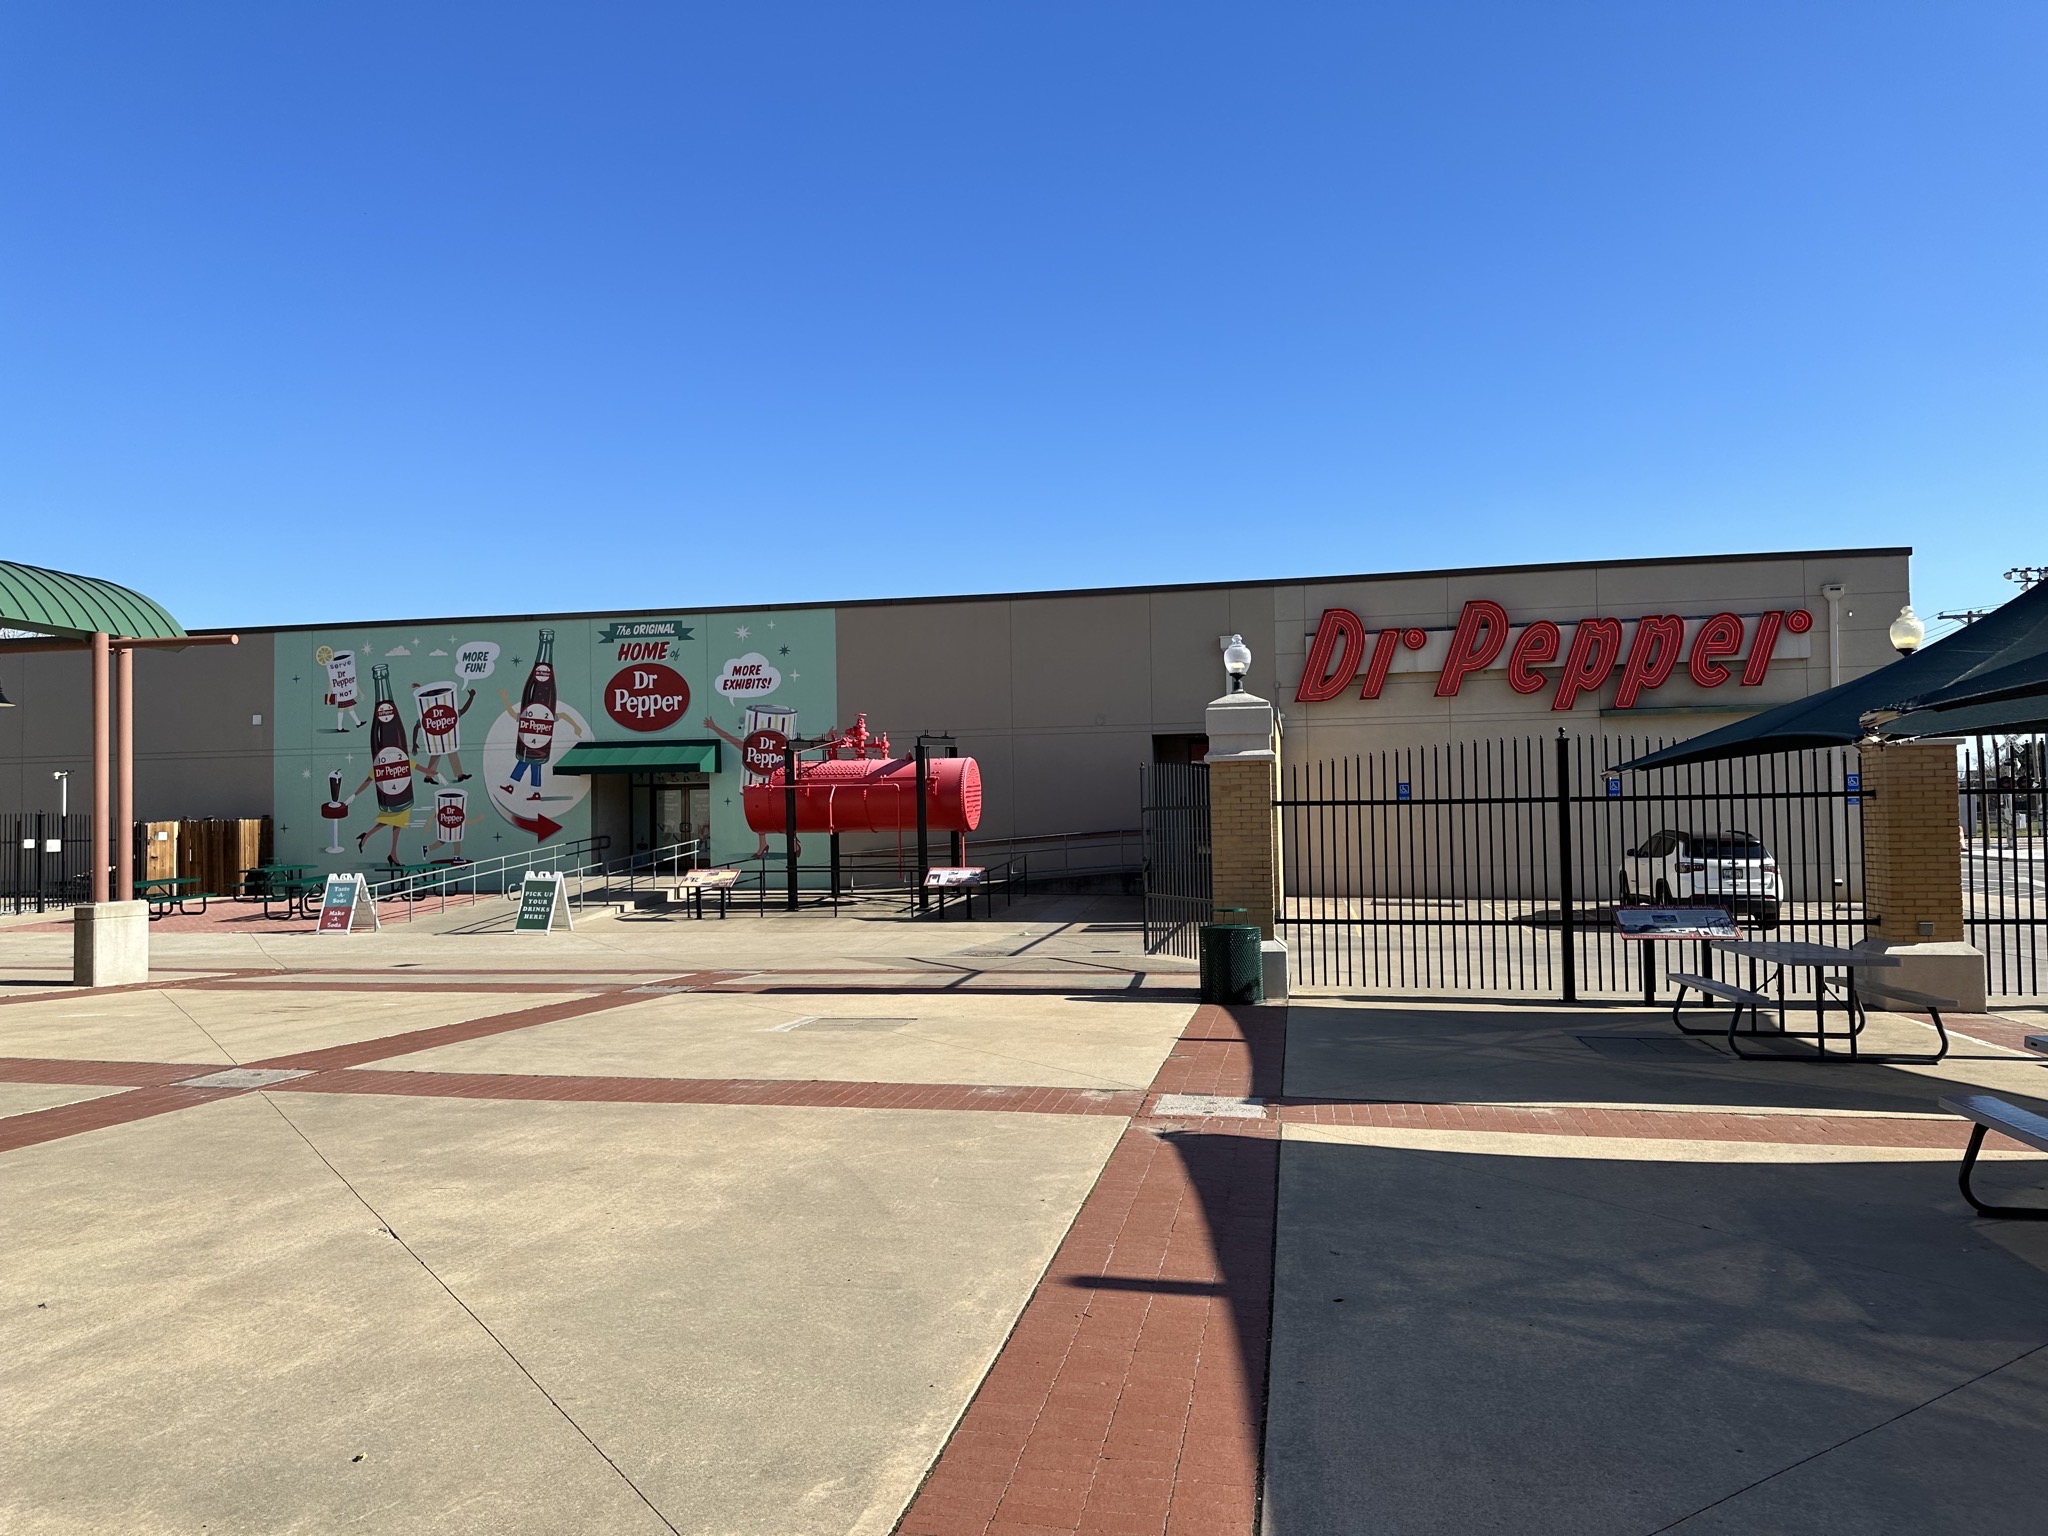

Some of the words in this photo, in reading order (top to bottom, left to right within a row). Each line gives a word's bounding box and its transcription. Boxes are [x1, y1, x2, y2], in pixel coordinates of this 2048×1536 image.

[616, 625, 631, 636] The
[633, 623, 675, 635] ORIGINAL
[462, 651, 489, 662] MORE
[617, 641, 671, 662] HOME
[670, 647, 680, 661] of
[1294, 607, 1427, 703] Dr
[1433, 600, 1814, 711] Pepper
[464, 662, 487, 673] FUN!
[732, 664, 762, 676] MORE
[337, 671, 346, 679] Dr
[633, 670, 658, 690] Dr
[332, 676, 355, 688] Pepper
[722, 677, 772, 690] EXHIBITS!
[339, 690, 352, 698] HOT
[614, 688, 683, 719] Pepper
[433, 709, 444, 718] Dr
[525, 710, 533, 718] 10
[425, 716, 456, 731] Pepper
[520, 720, 530, 729] Dr
[529, 720, 553, 733] Pepper
[759, 736, 776, 750] Dr
[746, 747, 784, 769] Peppe
[375, 768, 384, 778] Dr
[385, 765, 409, 778] Pepper
[446, 807, 455, 815] Dr
[440, 813, 463, 825] Pepper
